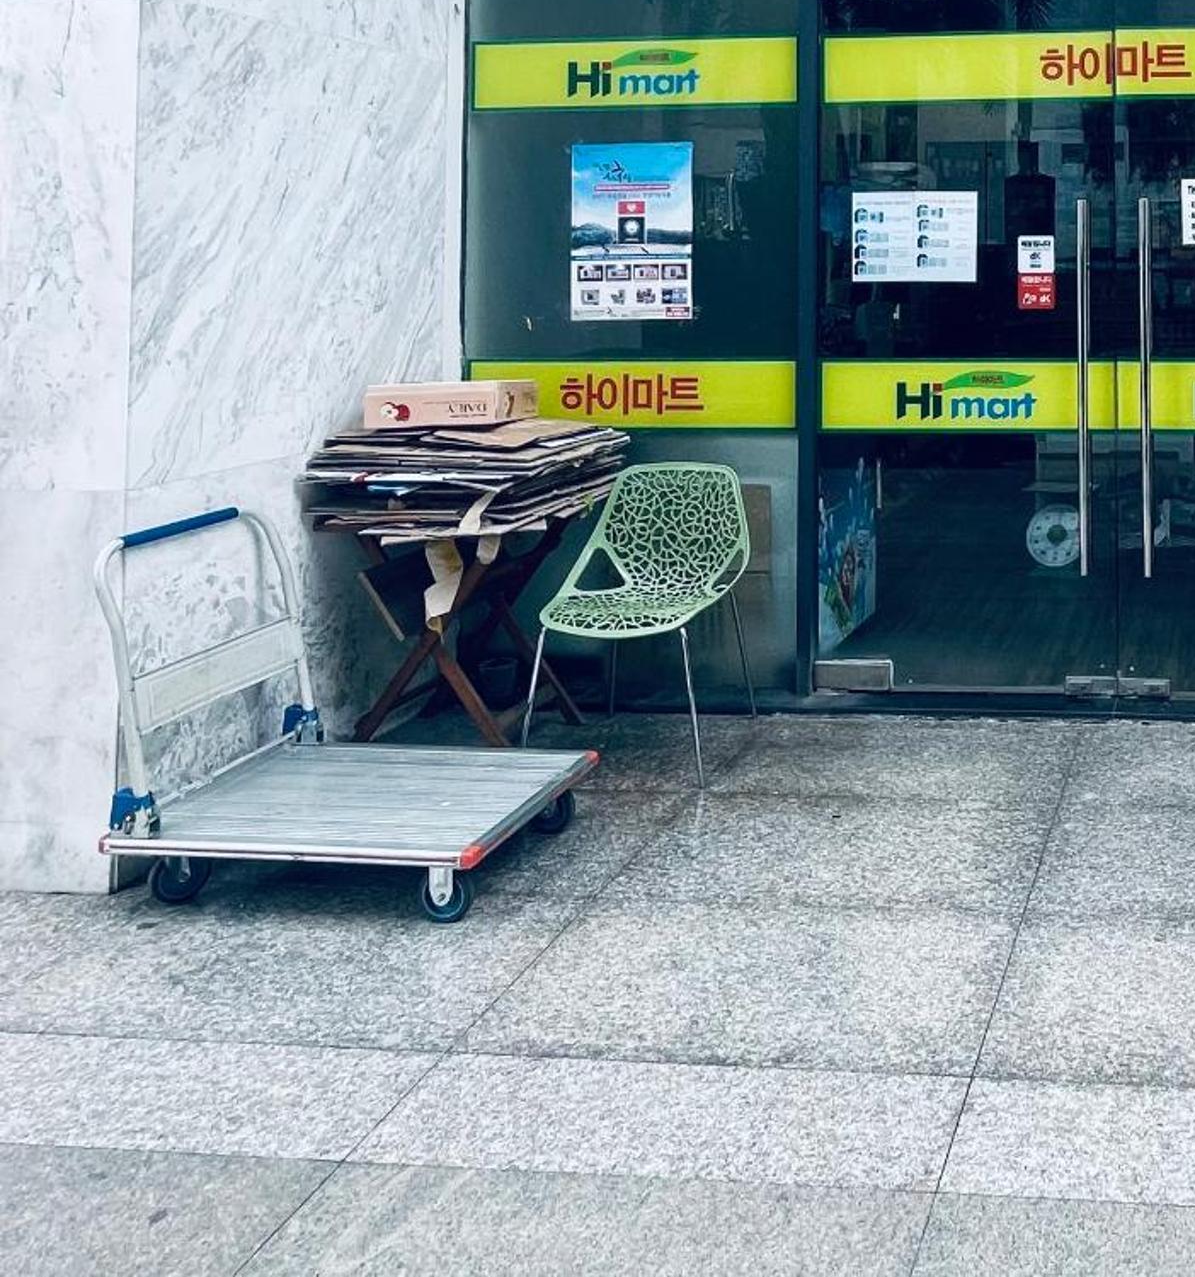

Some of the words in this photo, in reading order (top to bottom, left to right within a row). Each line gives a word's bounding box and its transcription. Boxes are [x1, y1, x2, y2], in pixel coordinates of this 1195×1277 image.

[567, 61, 612, 98] Hi
[619, 68, 700, 95] mart
[1040, 41, 1191, 86] 하이마트
[560, 373, 704, 415] 하이마트
[895, 381, 943, 420] Hi
[950, 391, 1037, 419] mart
